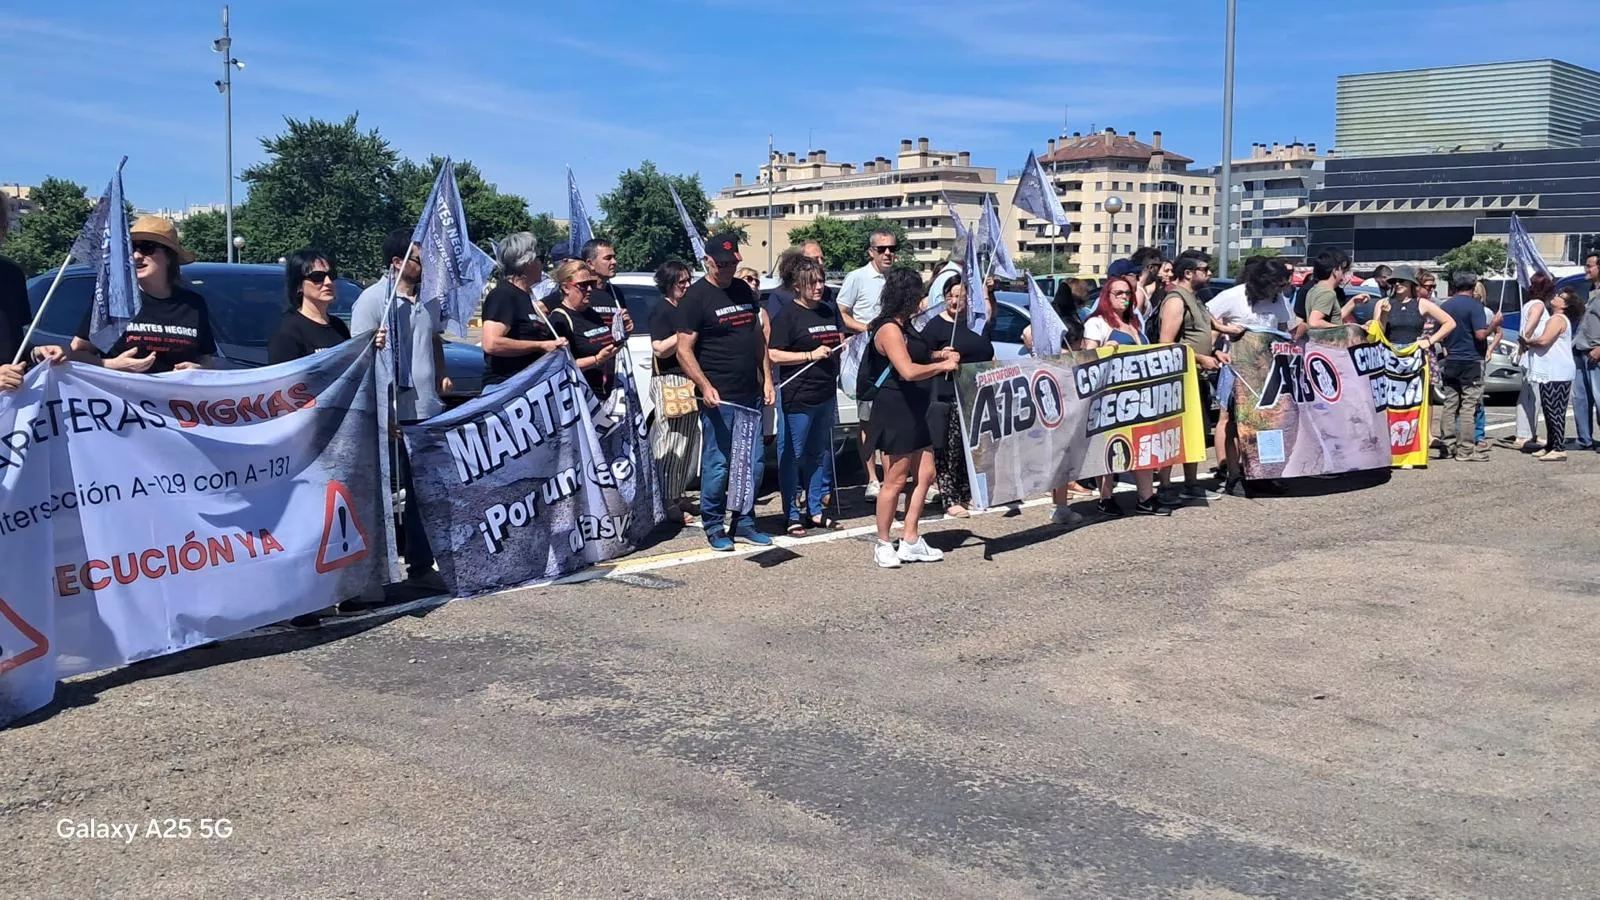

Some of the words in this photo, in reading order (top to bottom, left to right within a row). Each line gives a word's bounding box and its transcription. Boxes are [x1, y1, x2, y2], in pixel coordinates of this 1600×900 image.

[126, 322, 163, 333] MARTES
[164, 325, 198, 338] NEGROS
[169, 382, 317, 428] DIGNAS
[446, 364, 581, 485] MARTE
[1087, 381, 1183, 432] SEGURA
[131, 477, 186, 498] A-129
[194, 470, 238, 492] con
[245, 456, 290, 484] A-131
[52, 530, 235, 597] ECUCIÓN
[235, 528, 285, 559] YA
